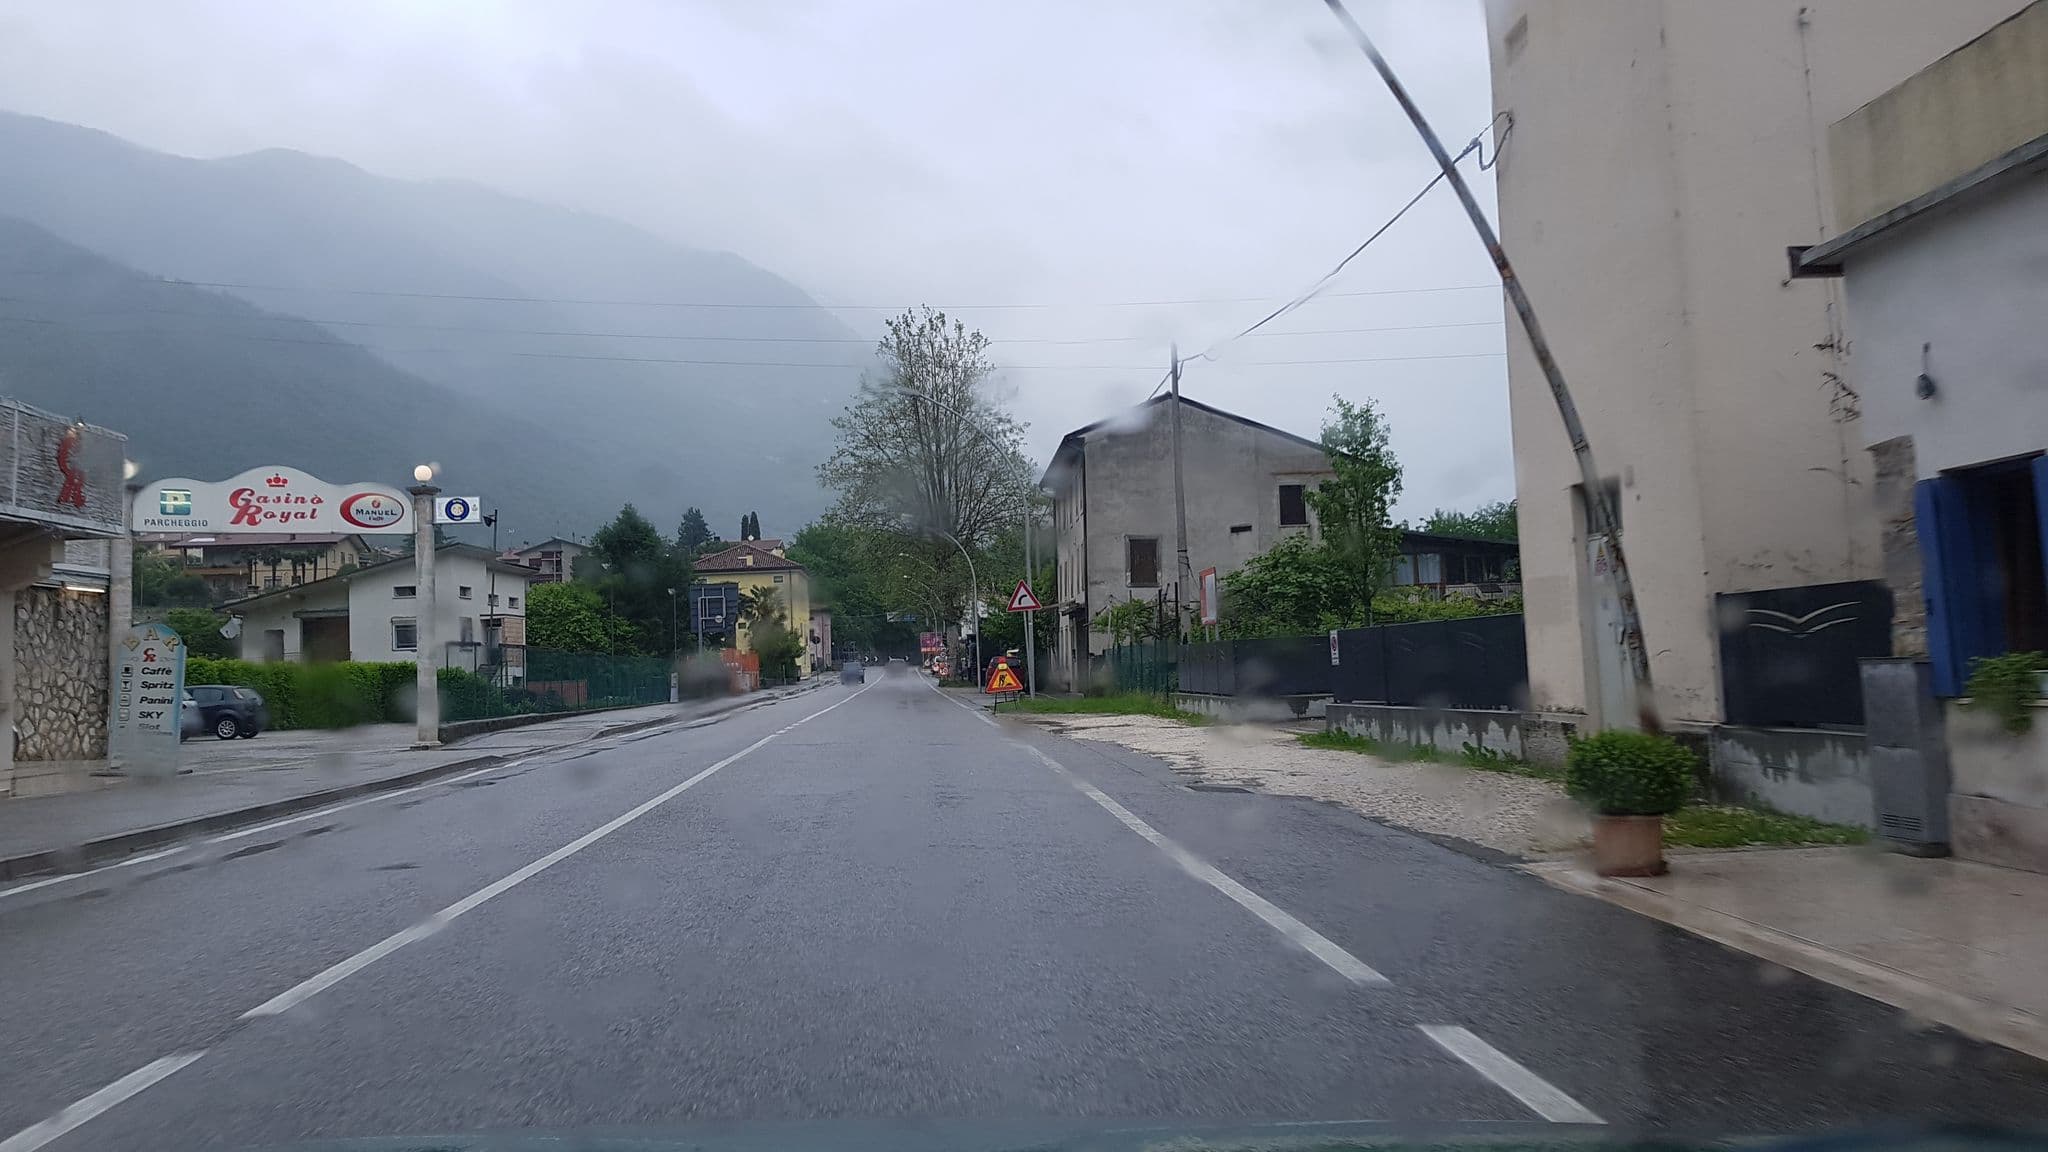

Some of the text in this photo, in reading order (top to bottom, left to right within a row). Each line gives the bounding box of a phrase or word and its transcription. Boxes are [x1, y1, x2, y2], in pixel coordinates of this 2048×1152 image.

[230, 503, 318, 526] Royal
[355, 508, 398, 516] MANUEL
[144, 518, 209, 527] PARCHEGGIO
[141, 667, 172, 676] Caffè
[140, 680, 174, 690] Spritz
[139, 696, 174, 705] Panini
[138, 711, 164, 719] SKY
